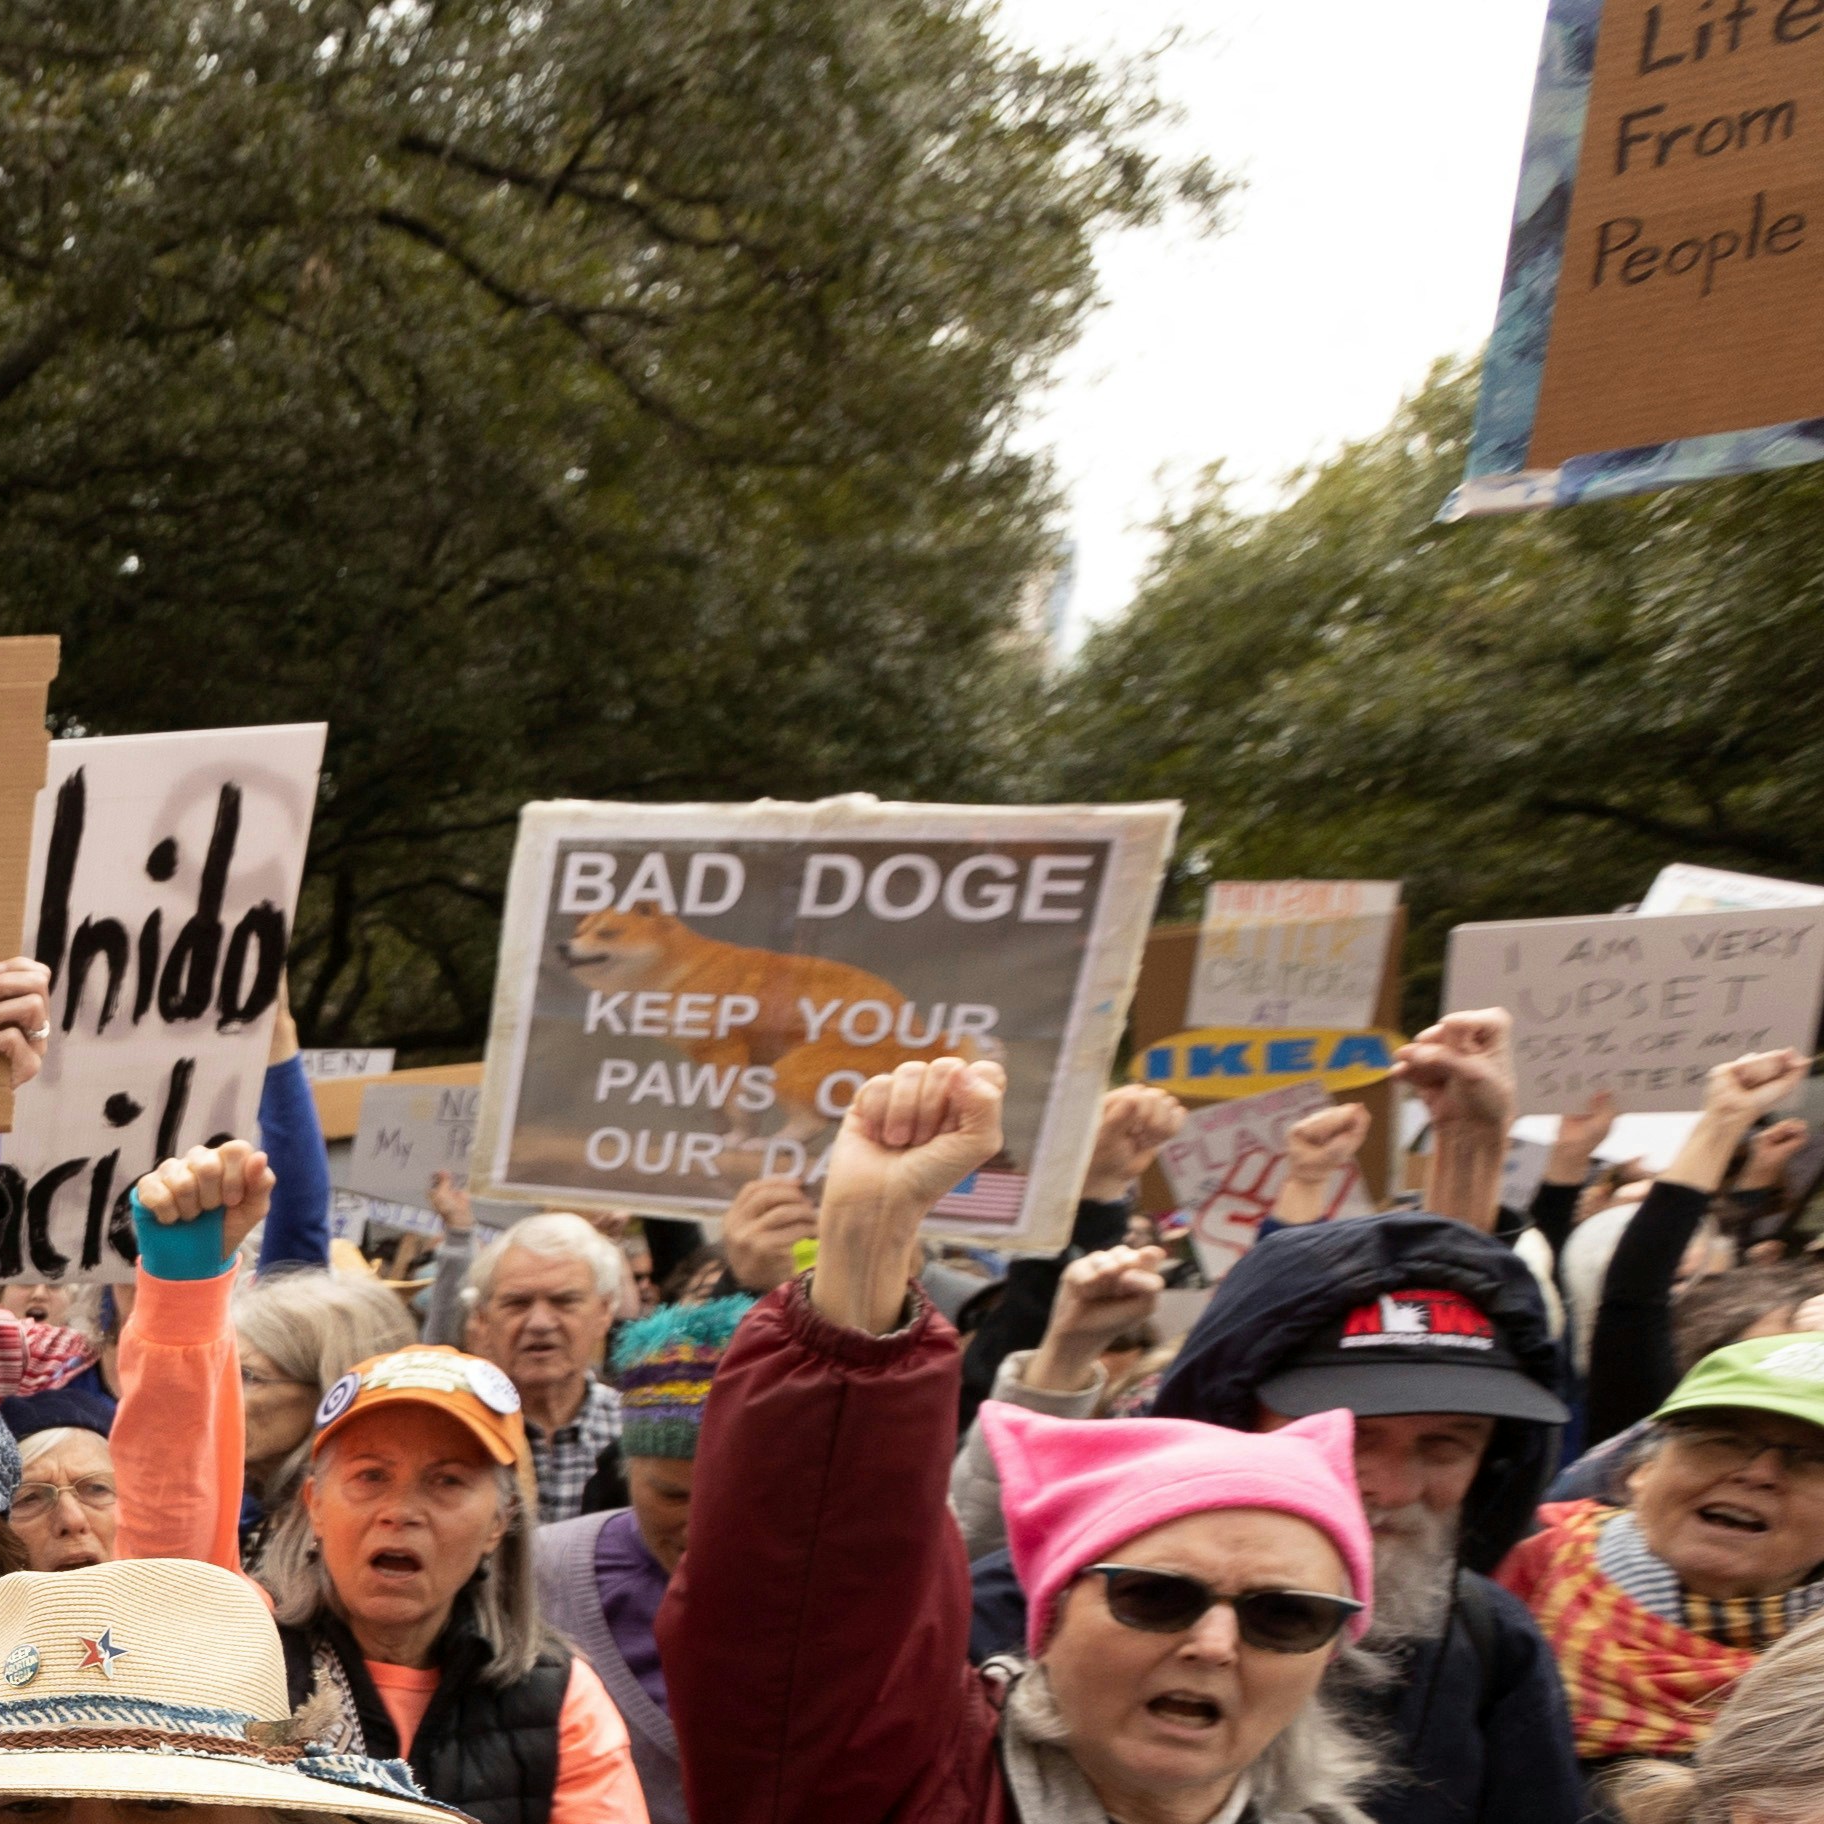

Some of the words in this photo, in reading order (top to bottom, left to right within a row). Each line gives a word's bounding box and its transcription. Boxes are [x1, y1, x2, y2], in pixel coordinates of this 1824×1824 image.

[1615, 101, 1796, 175] From
[1589, 191, 1807, 297] People
[556, 850, 746, 917] BAD
[797, 852, 1095, 924] DOGE
[1505, 941, 1521, 975] I
[1559, 936, 1644, 965] AM
[1681, 923, 1816, 961] VERY
[583, 990, 759, 1040] KEEP
[797, 996, 1000, 1050] YOUR
[1517, 973, 1770, 1024] UPSET
[1145, 1034, 1393, 1081] IKEA
[594, 1058, 778, 1113] PAWS
[585, 1126, 723, 1177] OUR
